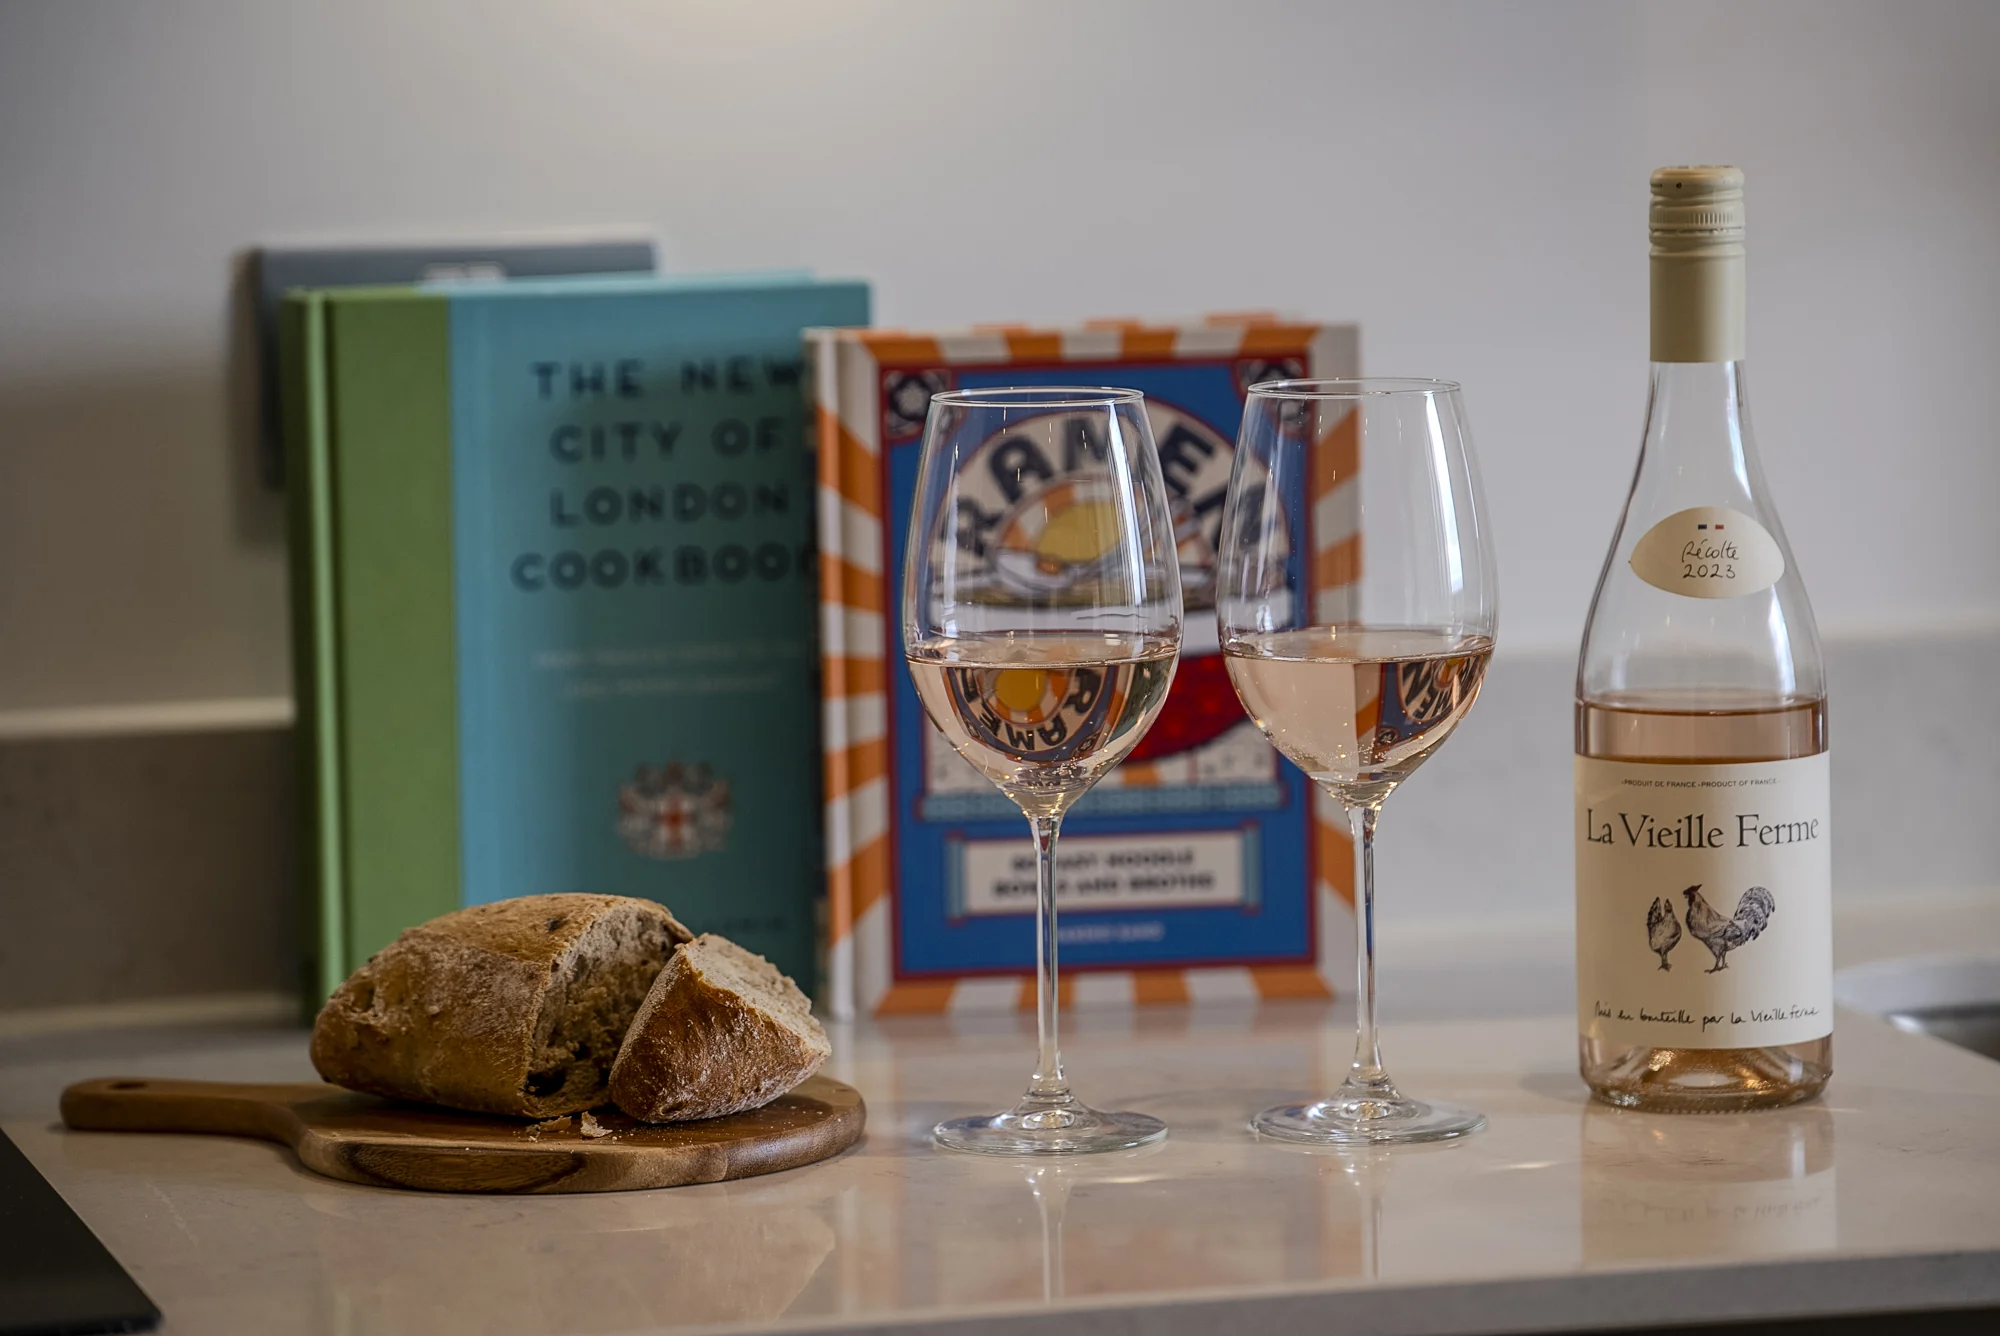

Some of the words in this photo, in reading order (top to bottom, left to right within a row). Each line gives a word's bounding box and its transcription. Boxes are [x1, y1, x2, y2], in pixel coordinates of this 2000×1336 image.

[528, 358, 646, 399] THE
[680, 356, 806, 396] NEW
[549, 420, 683, 465] CITY
[711, 416, 785, 459] OF
[549, 480, 792, 529] LONDON
[1682, 538, 1739, 562] Récolte
[1683, 564, 1736, 579] 2023
[1655, 780, 1664, 788] DE
[1667, 780, 1696, 788] FRANCE
[1701, 780, 1736, 788] PRODUCT
[1739, 779, 1749, 787] OF
[1751, 778, 1777, 786] FRANCE
[1587, 808, 1614, 844] La
[1619, 812, 1724, 849] Vieille
[1735, 813, 1819, 848] Ferme
[1701, 1015, 1724, 1033] par
